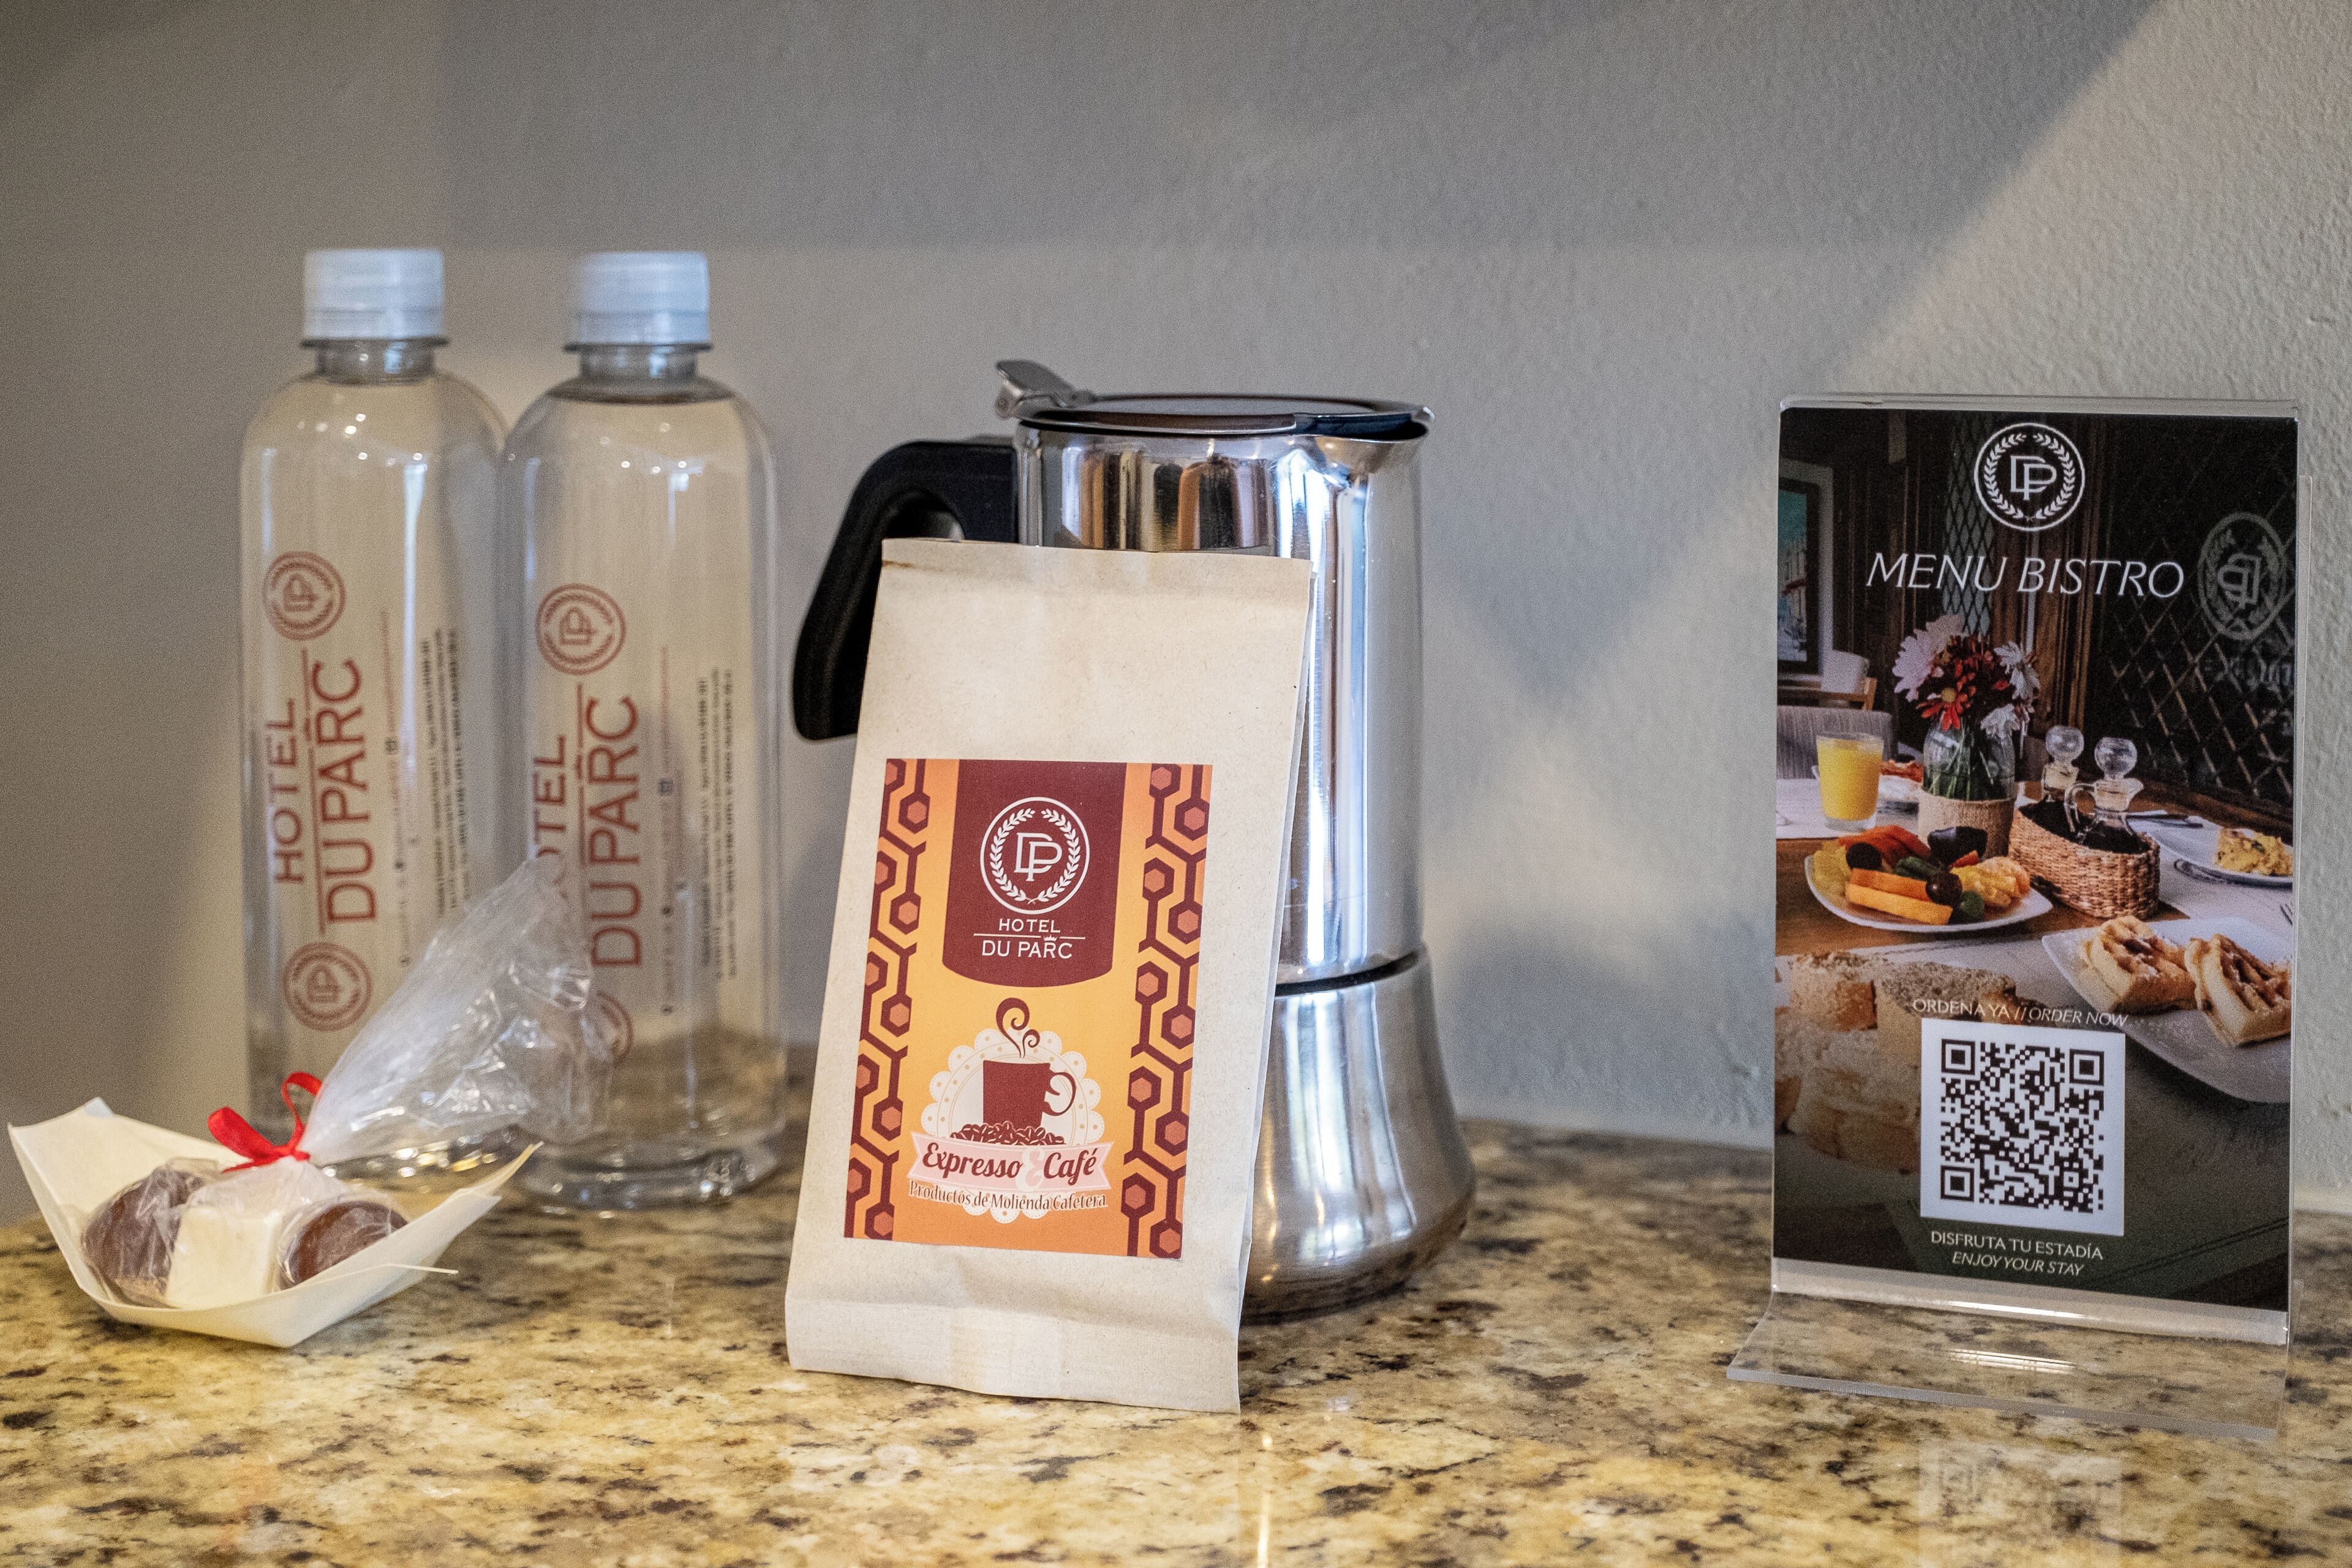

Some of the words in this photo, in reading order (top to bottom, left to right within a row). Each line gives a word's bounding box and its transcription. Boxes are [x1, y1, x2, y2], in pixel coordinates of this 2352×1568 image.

[1866, 552, 2008, 592] MENU
[2017, 557, 2185, 598] BISTRO
[311, 658, 372, 823] PARC
[266, 698, 305, 884] HOTEL
[533, 733, 567, 858] TEL
[585, 694, 641, 865] PARC
[322, 838, 377, 922] DU
[590, 880, 643, 968] DU
[998, 918, 1061, 933] HOTEL
[981, 940, 1011, 957] DU
[1017, 941, 1073, 960] PARC
[1912, 998, 1985, 1017] ORDENA
[1988, 1005, 2011, 1020] YA
[2029, 1006, 2082, 1024] ORDER
[2086, 1011, 2128, 1027] NOW
[922, 1142, 1023, 1179] Expresso
[1043, 1147, 1098, 1186] Café
[909, 1180, 973, 1206] Productos
[974, 1192, 989, 1207] de
[990, 1193, 1050, 1210] Molienda
[1053, 1192, 1108, 1210] Cafetera
[1931, 1231, 2006, 1251] DISFRUTA
[2008, 1237, 2031, 1254] TU
[2035, 1241, 2103, 1261] ESTADÍA
[1951, 1251, 2002, 1268] ENJOY
[2003, 1257, 2045, 1273] YOUR
[2047, 1261, 2085, 1276] STAY
